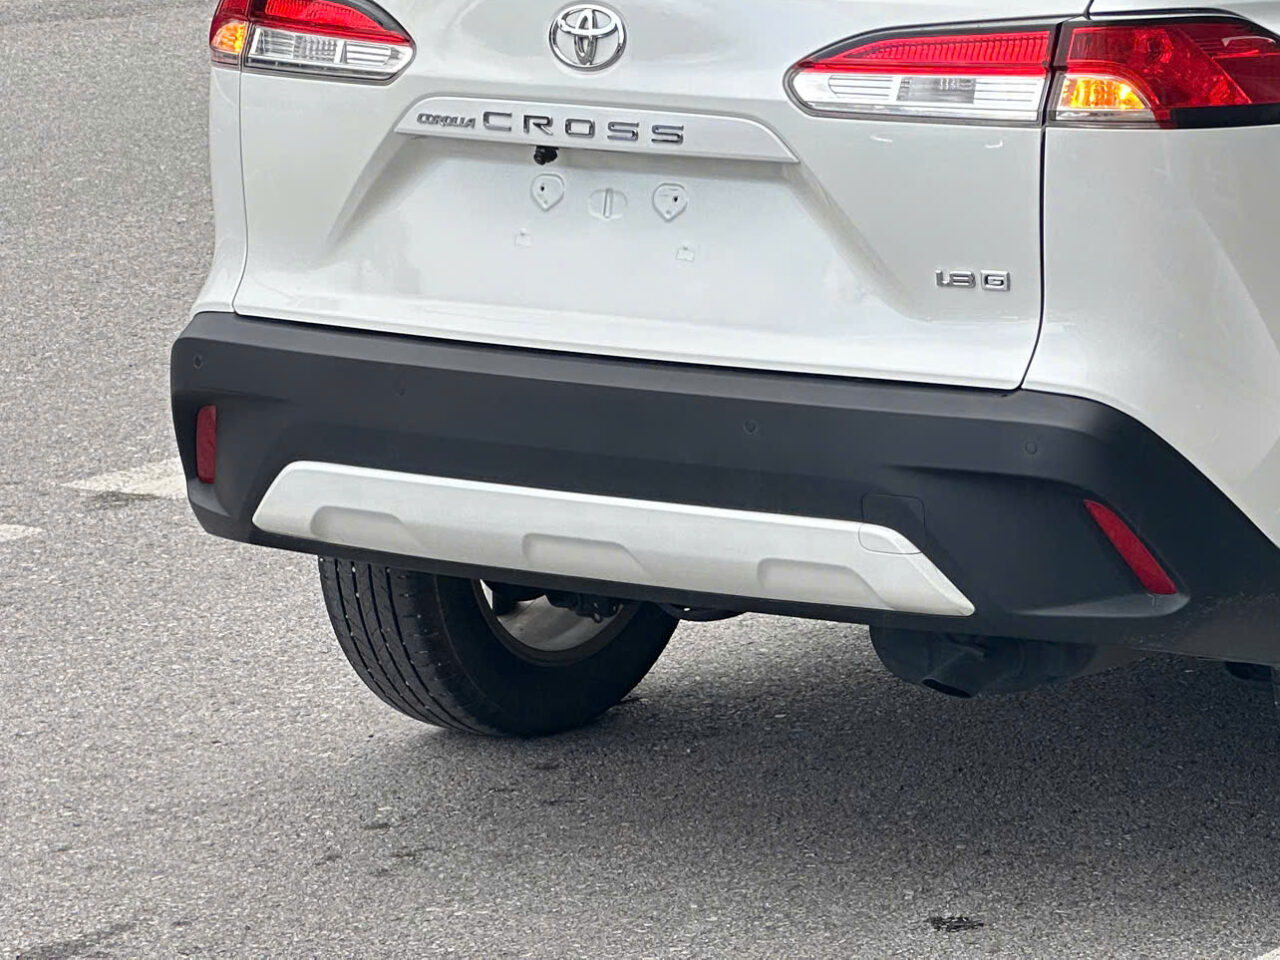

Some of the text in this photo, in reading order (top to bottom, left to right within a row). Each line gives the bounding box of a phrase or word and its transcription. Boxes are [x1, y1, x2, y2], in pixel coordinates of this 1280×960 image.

[417, 111, 685, 146] COROLLA CROSS
[980, 269, 1010, 291] G
